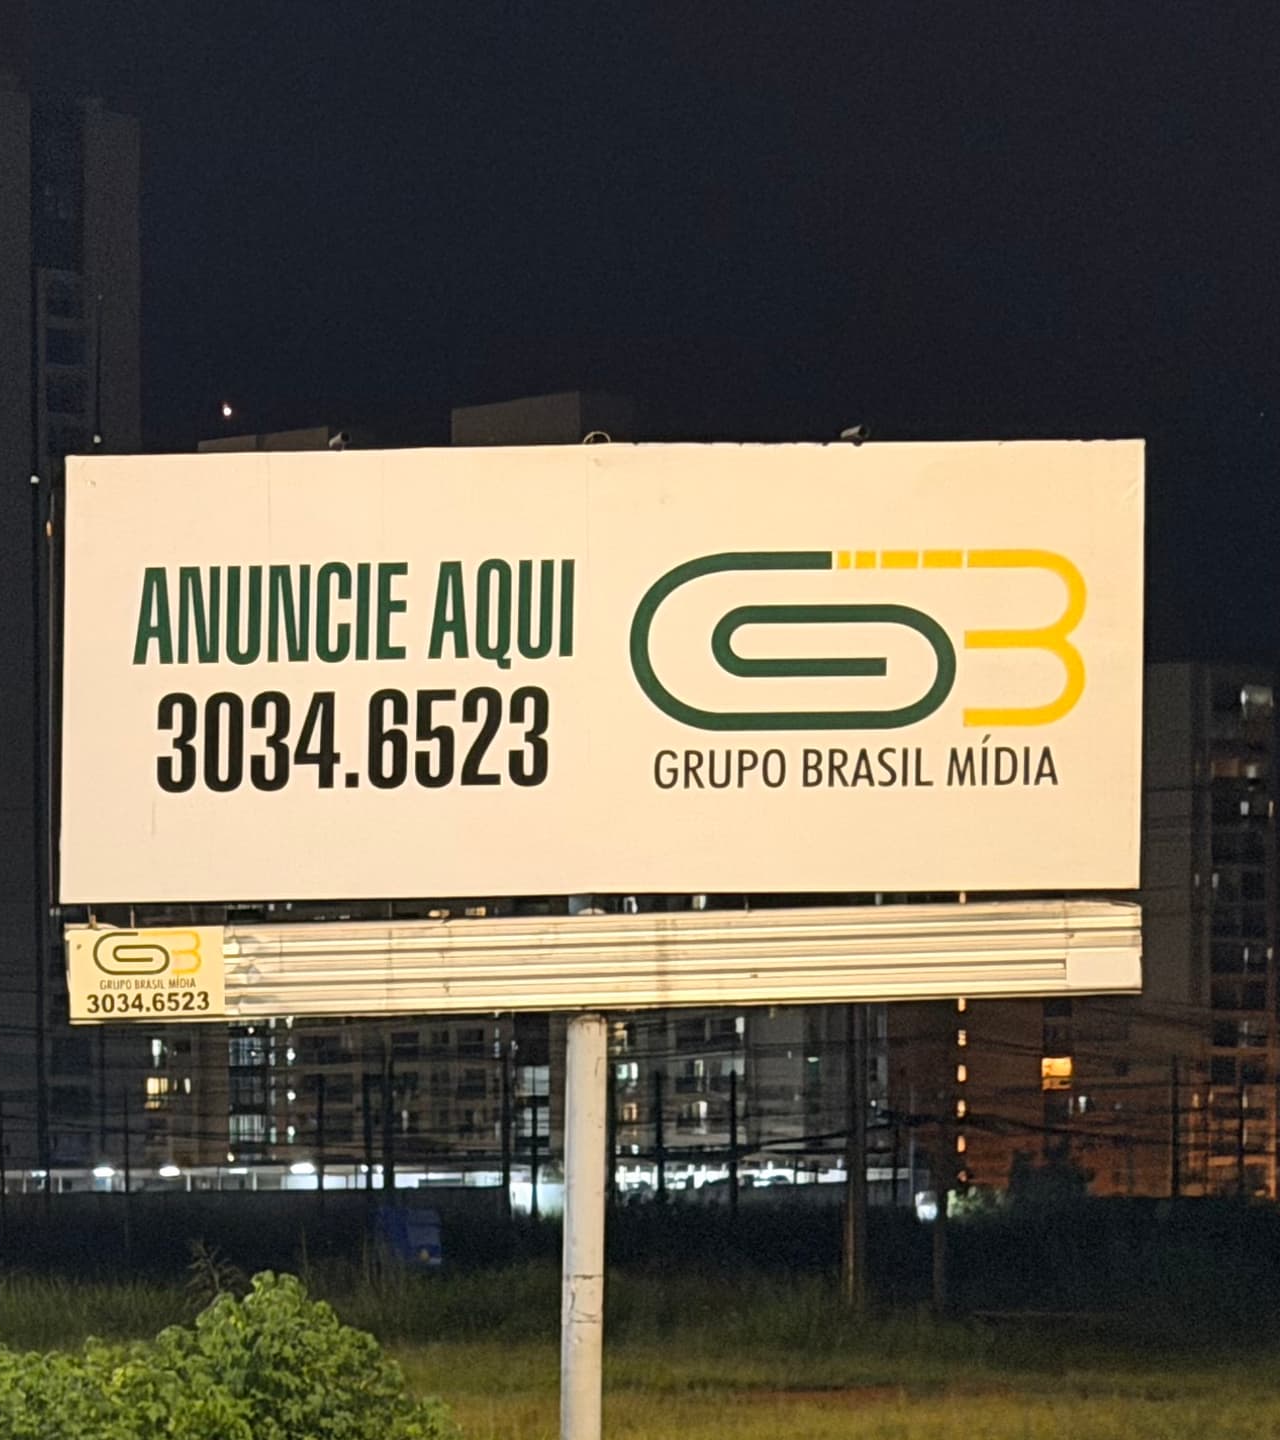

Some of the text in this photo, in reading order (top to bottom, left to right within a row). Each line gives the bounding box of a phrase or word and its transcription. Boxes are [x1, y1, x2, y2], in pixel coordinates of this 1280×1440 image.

[132, 558, 576, 670] ANUNCIE AQUI
[155, 685, 550, 793] 3034.6523
[653, 734, 1059, 789] GRUPO BRASIL MÍDIA
[86, 990, 210, 1014] 3034.6523
[99, 975, 197, 991] GRUPO BRASIL MÍDIA
